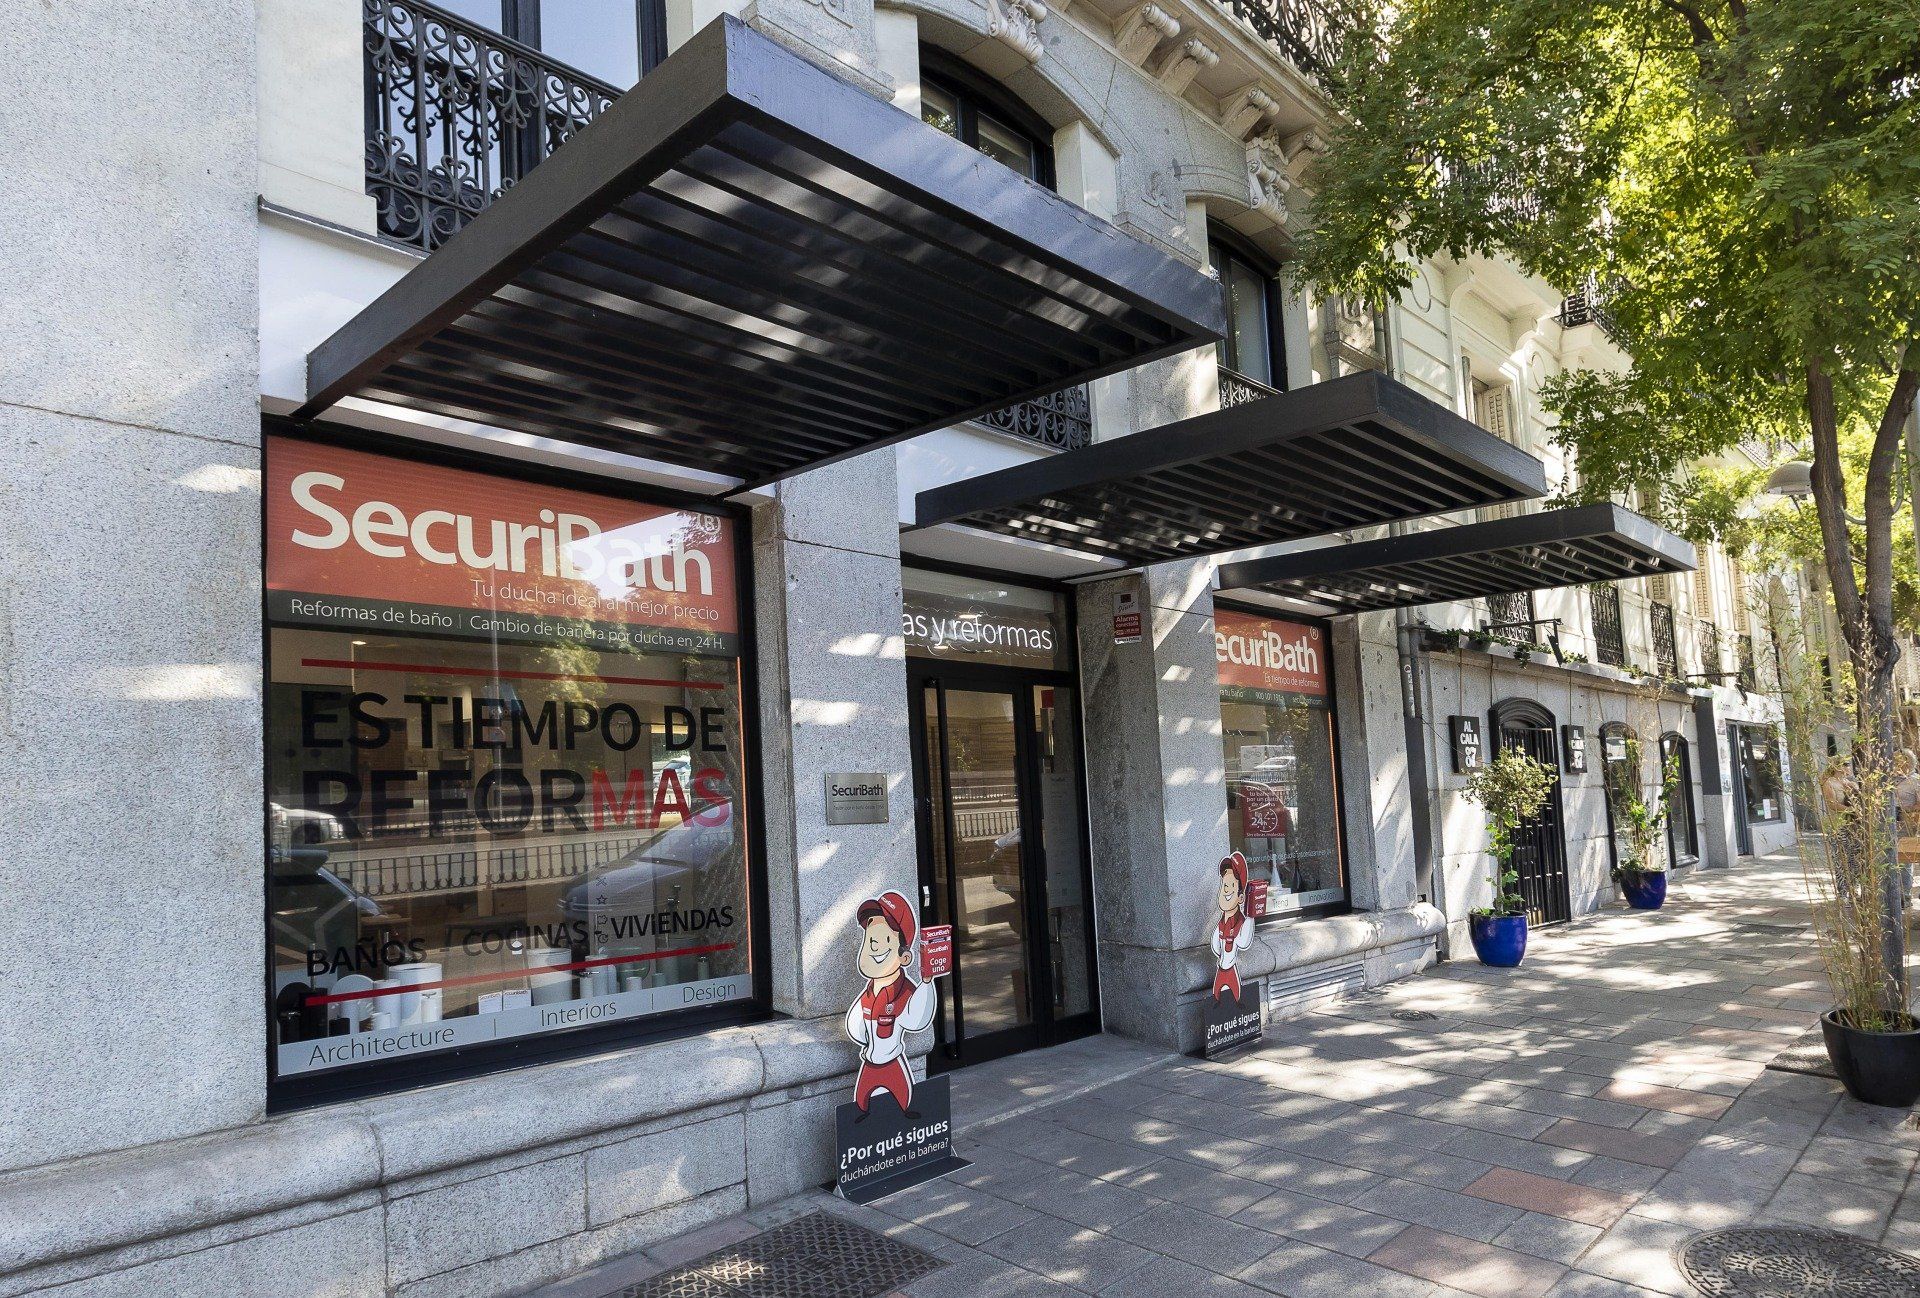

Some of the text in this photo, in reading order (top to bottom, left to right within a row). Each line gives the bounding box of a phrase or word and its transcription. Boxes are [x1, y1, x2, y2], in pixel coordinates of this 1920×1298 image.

[290, 471, 713, 596] SecuriBath
[471, 579, 494, 598] Tu
[499, 583, 557, 604] ducha
[561, 589, 601, 608] ideal
[624, 599, 669, 618] mejor
[673, 604, 719, 621] precio
[290, 598, 378, 621] Reformas
[382, 606, 405, 623] de
[410, 609, 454, 628] baño
[469, 614, 530, 634] Cambio
[533, 621, 554, 637] de
[556, 624, 605, 641] bañera
[608, 630, 631, 644] por
[634, 632, 674, 647] ducha
[677, 638, 694, 647] en
[931, 616, 946, 647] y
[952, 612, 1053, 651] reformas
[1298, 677, 1320, 689] reformas
[301, 690, 728, 753] ES TIEMPO DE
[1460, 732, 1479, 746] CALA
[1463, 720, 1474, 733] AL
[301, 767, 731, 842] REFORMAS
[831, 783, 884, 797] SecuriBath
[306, 905, 734, 978] BAÑOS COCINAS VIVIENDAS
[929, 957, 947, 966] Coge
[932, 965, 945, 973] uno
[308, 982, 738, 1067] Architecture Interiors Design
[1207, 1011, 1260, 1040] ¿Por qué sigues
[840, 1120, 949, 1170] ¿Por qué sigues
[840, 1137, 949, 1184] duchándote en la bañera?
